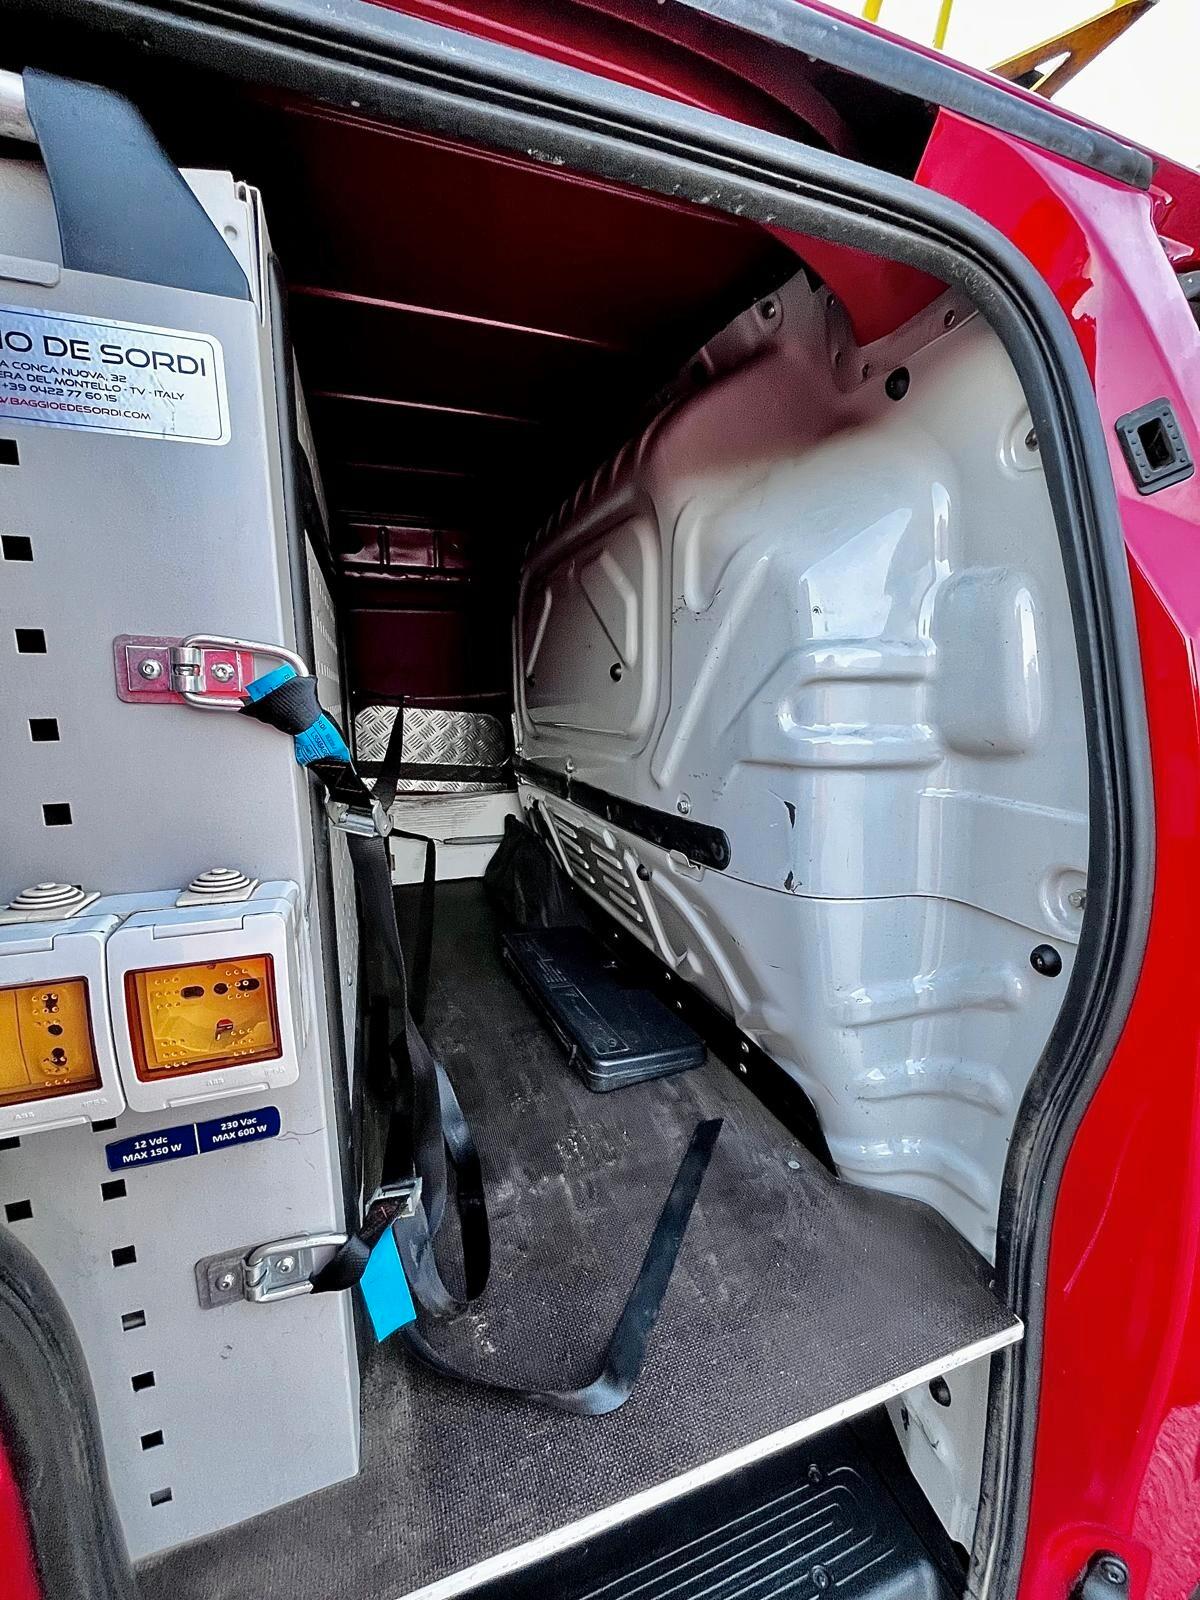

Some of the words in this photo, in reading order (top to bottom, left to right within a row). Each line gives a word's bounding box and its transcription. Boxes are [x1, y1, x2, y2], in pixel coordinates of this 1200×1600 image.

[43, 335, 91, 361] DE
[100, 344, 206, 377] SORDI
[12, 361, 59, 374] CONCA
[110, 373, 127, 383] 32
[2, 382, 27, 392] +39
[31, 384, 64, 396] 0422
[67, 389, 82, 398] 77
[85, 391, 102, 400] 60
[105, 393, 118, 403] 15
[27, 373, 51, 385] DEL
[54, 378, 121, 393] MONTELLO
[130, 386, 146, 395] TV
[154, 389, 185, 401] ITALY
[220, 1120, 238, 1131] 230
[240, 1116, 257, 1127] Vac
[134, 1140, 147, 1150] 12
[149, 1136, 168, 1147] Vdc
[212, 1133, 236, 1144] MAX
[238, 1128, 255, 1138] 600
[257, 1124, 267, 1133] W
[122, 1151, 148, 1163] MAX
[150, 1146, 169, 1157] 150
[171, 1143, 182, 1152] W
